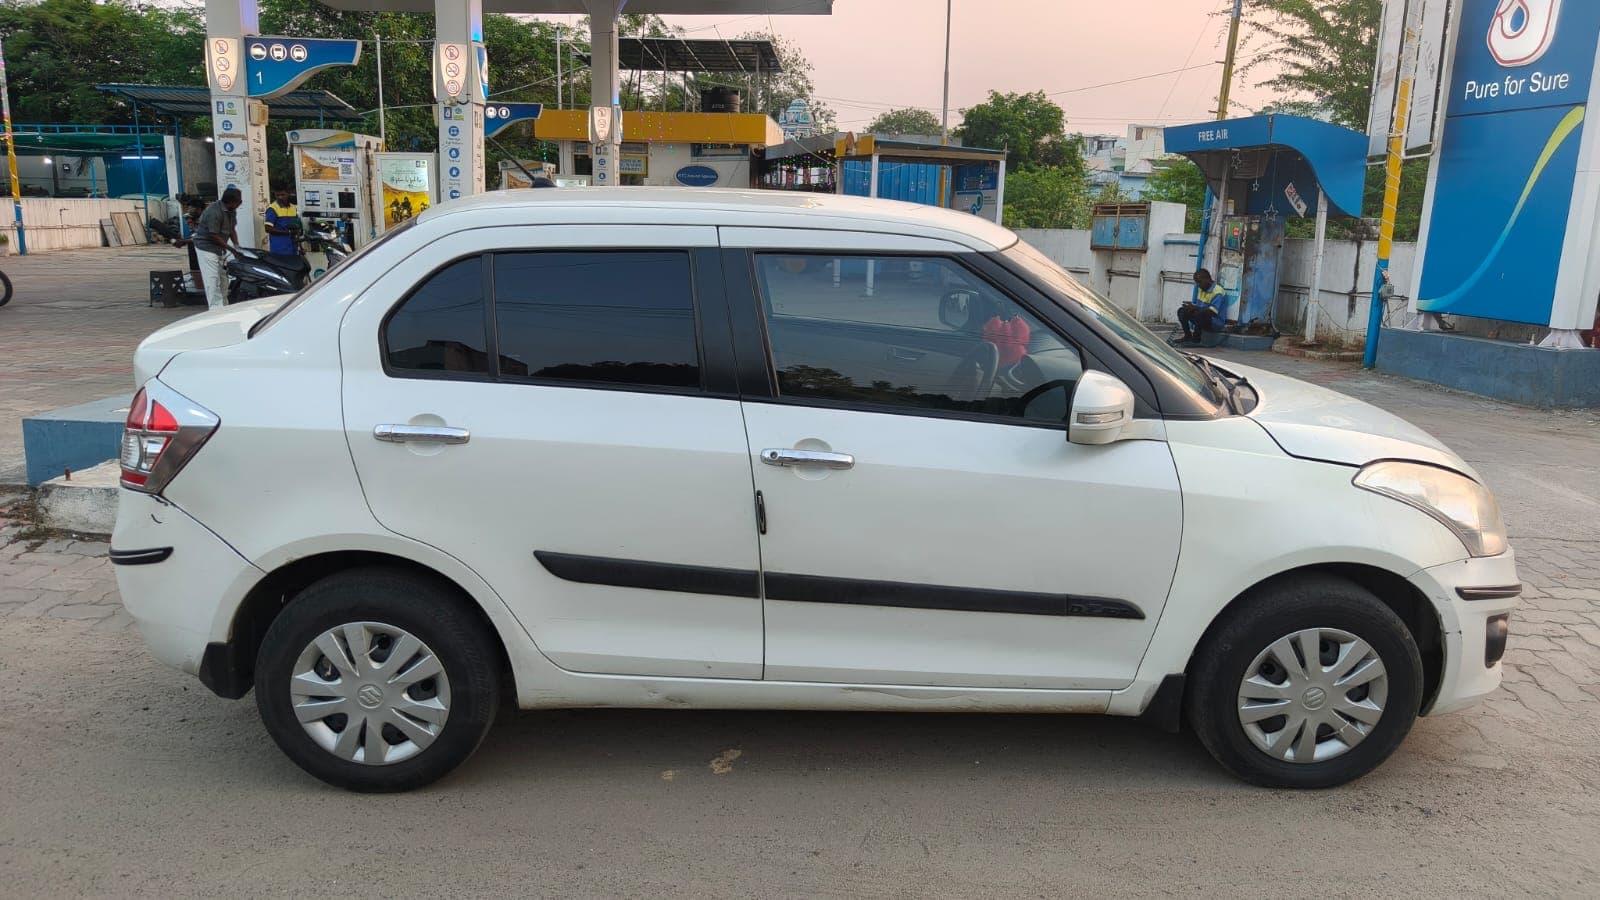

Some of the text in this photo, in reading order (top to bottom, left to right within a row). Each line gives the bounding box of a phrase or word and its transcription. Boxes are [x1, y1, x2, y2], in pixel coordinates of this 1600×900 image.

[256, 71, 262, 85] 1
[1465, 72, 1569, 100] Pure for Sure
[1198, 129, 1228, 142] FREE AIR
